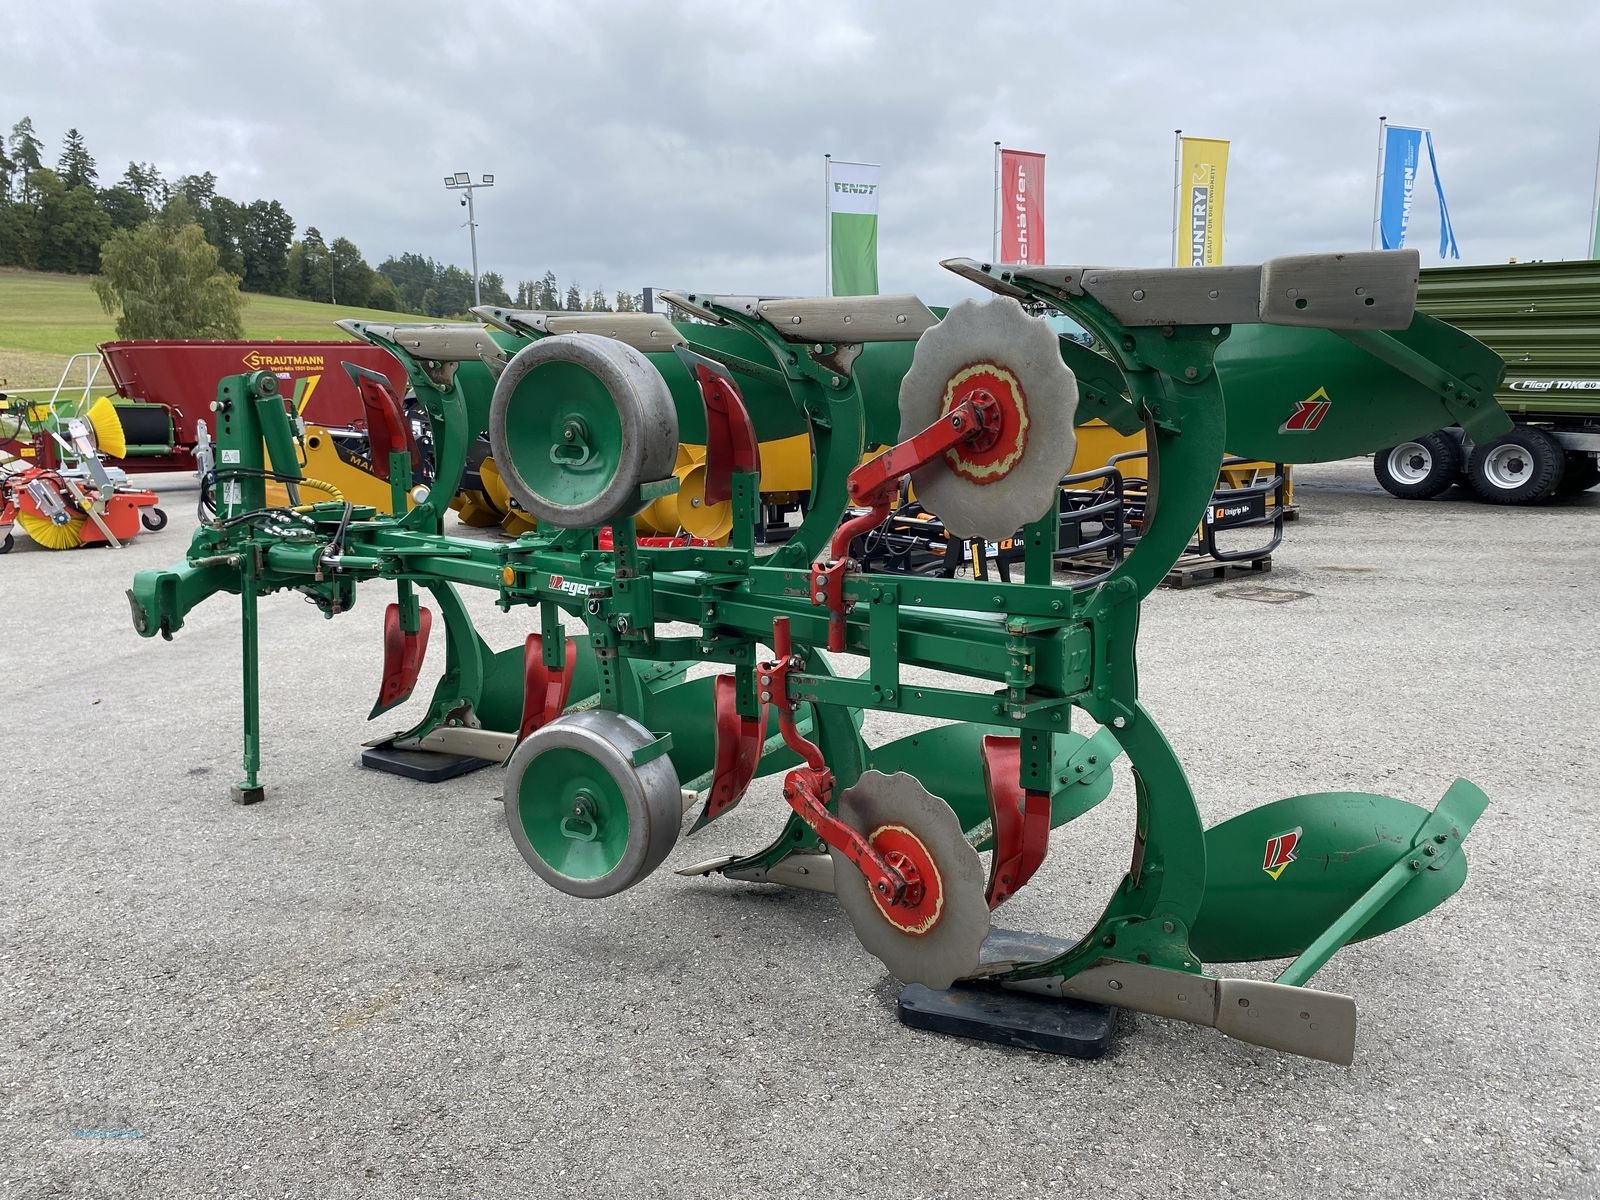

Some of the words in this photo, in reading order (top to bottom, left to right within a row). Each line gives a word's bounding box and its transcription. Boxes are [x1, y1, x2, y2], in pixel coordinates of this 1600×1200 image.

[834, 182, 878, 195] FENDT
[251, 355, 324, 366] STRAUTMANN
[1522, 381, 1554, 390] Fliegl
[1556, 381, 1580, 389] TDK
[1225, 507, 1242, 517] Unigrip
